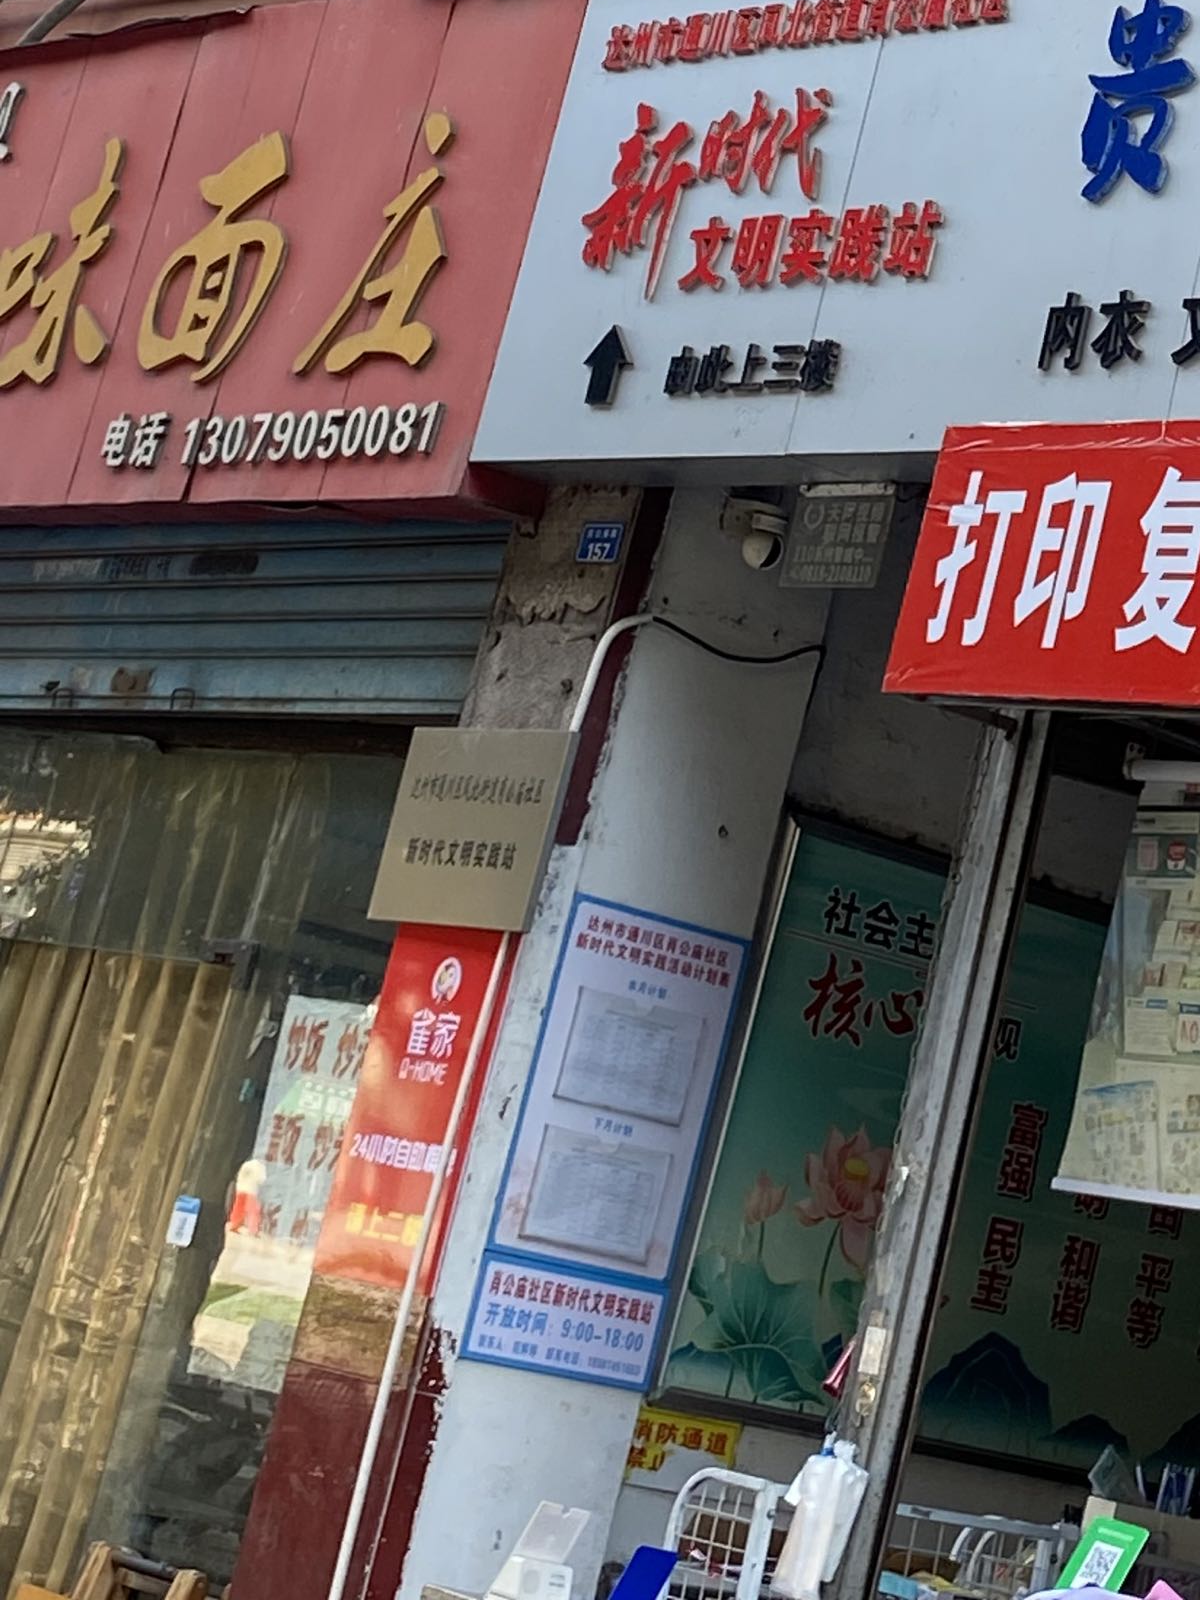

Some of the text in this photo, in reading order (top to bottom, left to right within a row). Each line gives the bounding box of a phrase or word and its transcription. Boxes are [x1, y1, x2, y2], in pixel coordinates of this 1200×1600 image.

[581, 87, 833, 301] 新时代
[678, 199, 944, 292] 文明实践站
[1037, 289, 1151, 371] 内衣
[101, 401, 447, 469] 电话 13079050081
[586, 542, 611, 561] 157
[926, 470, 1112, 649] 打印
[407, 1008, 462, 1058] 雀家
[804, 951, 925, 1047] 核心
[996, 1102, 1048, 1200] 富强
[969, 1215, 1024, 1314] 民主
[1126, 1253, 1174, 1350] 平等
